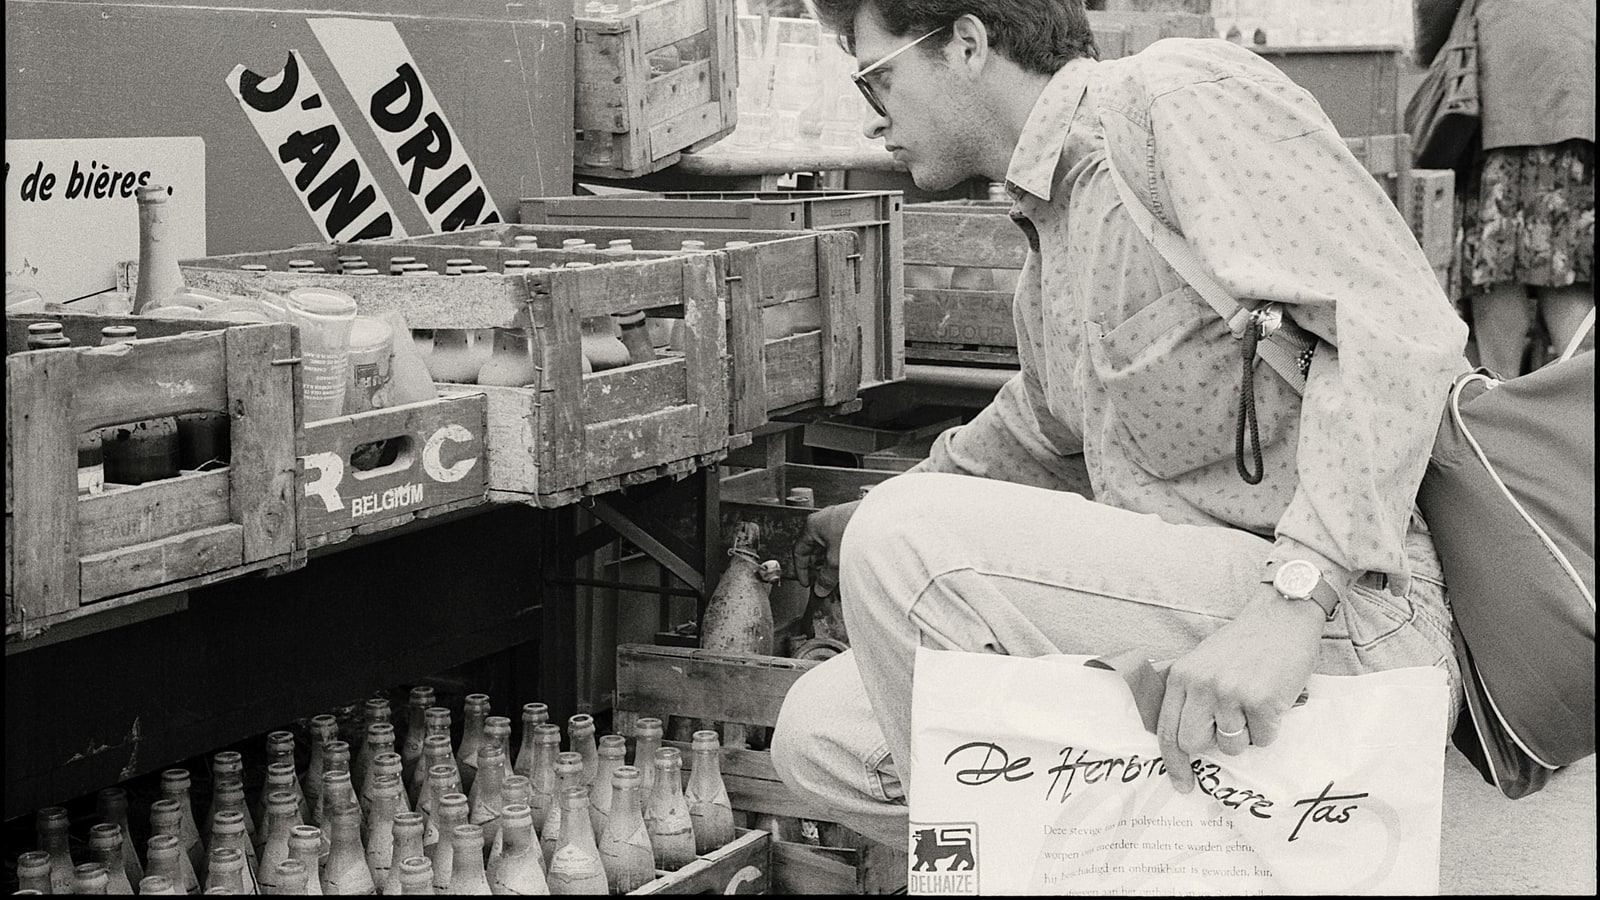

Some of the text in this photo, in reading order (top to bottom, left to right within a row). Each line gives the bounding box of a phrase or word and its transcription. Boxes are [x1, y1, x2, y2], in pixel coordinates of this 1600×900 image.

[20, 160, 56, 202] de
[351, 481, 424, 518] BELGIUM
[944, 742, 1035, 786] De
[1043, 824, 1067, 835] Deze
[1070, 827, 1102, 836] stevige
[1131, 815, 1193, 828] polyethyleen
[1200, 816, 1223, 827] werd
[1044, 851, 1079, 861] worpen
[1142, 840, 1171, 850] malen
[1174, 842, 1184, 850] te
[1187, 841, 1222, 852] worden
[911, 874, 973, 894] DELHAIZE
[1044, 873, 1057, 884] hij
[1191, 865, 1199, 874] is
